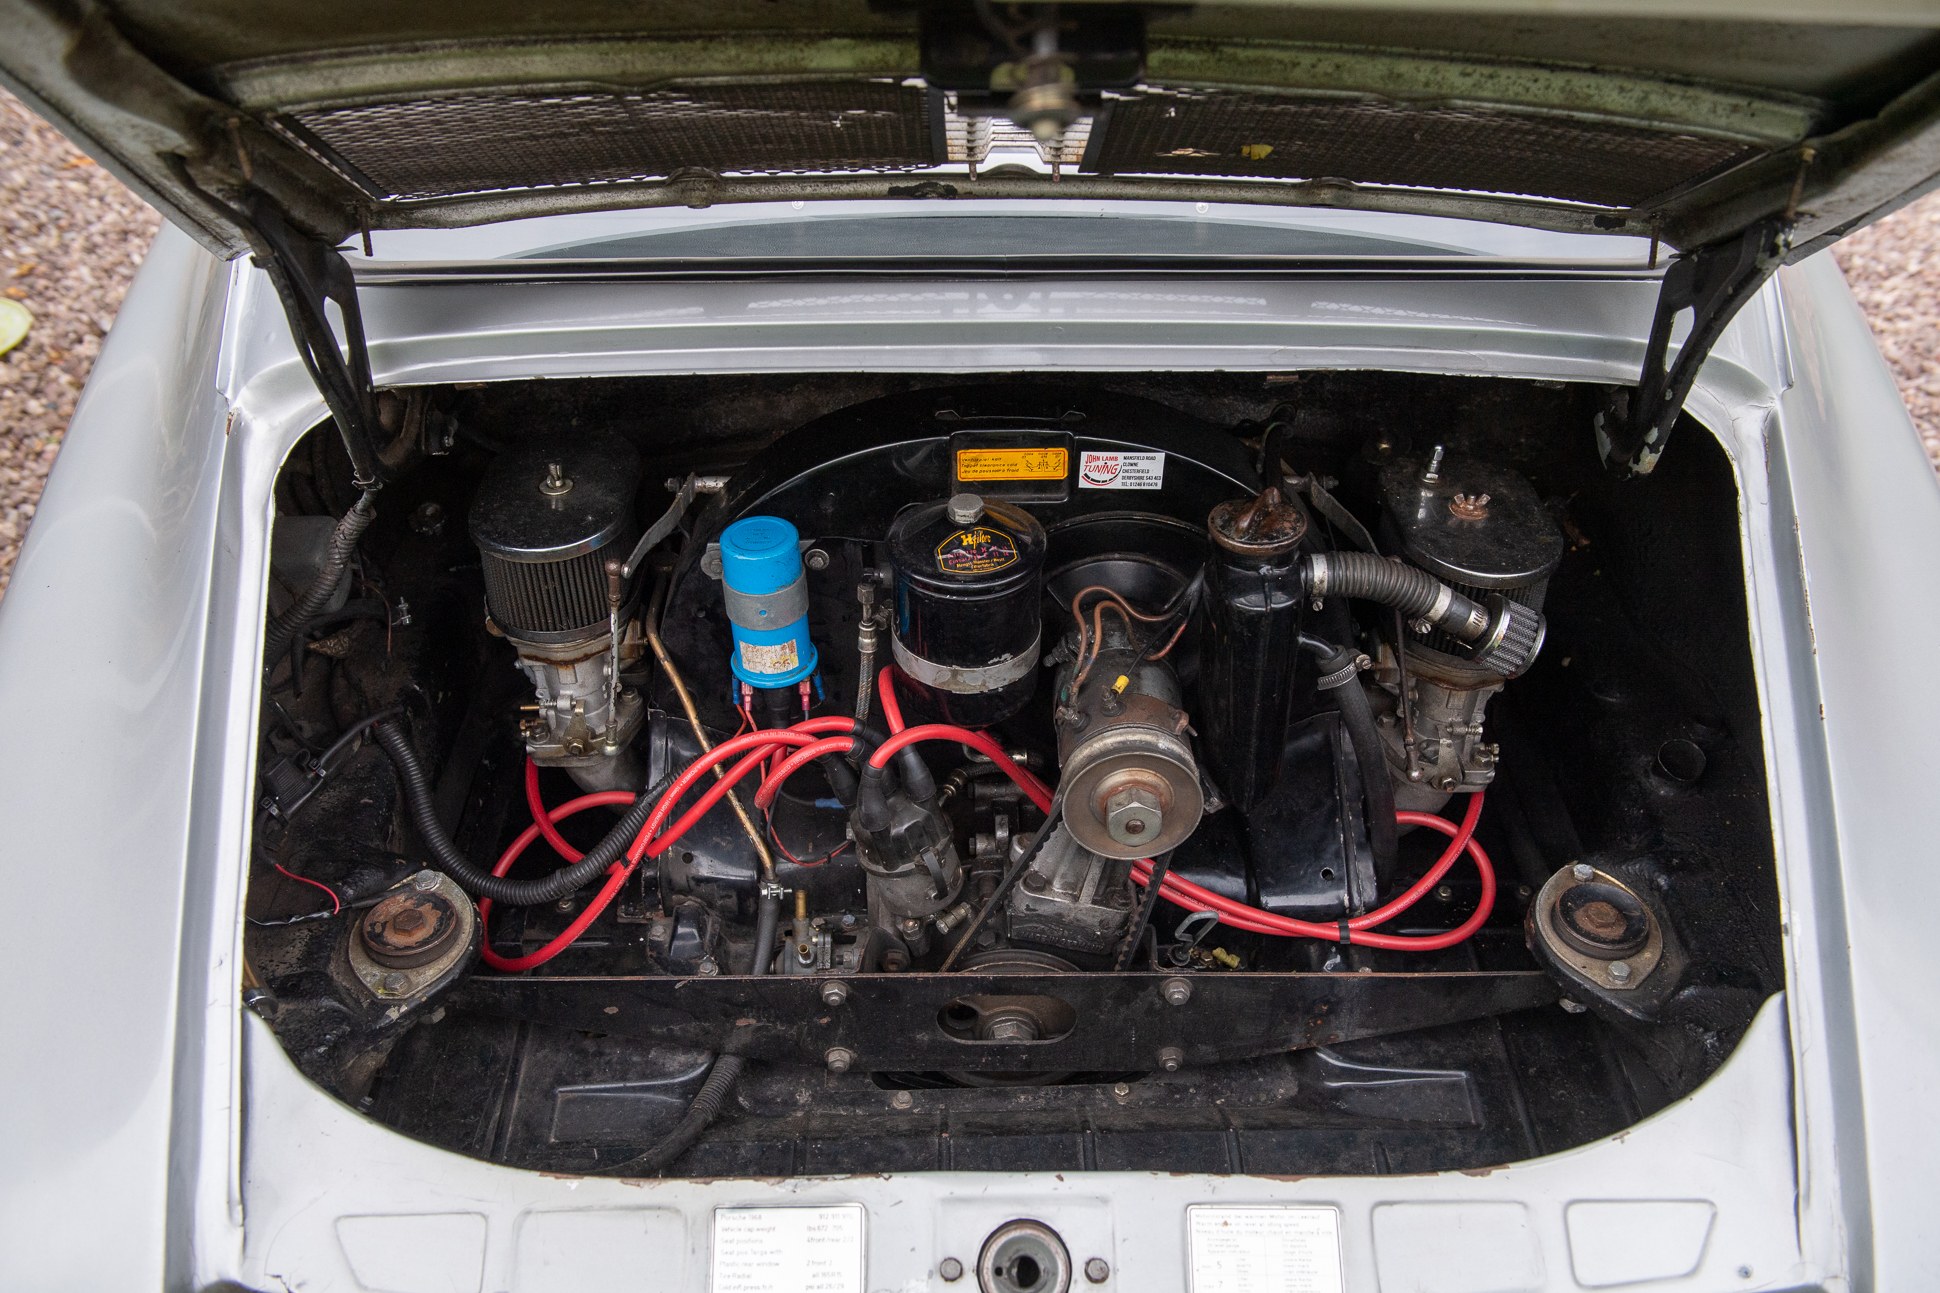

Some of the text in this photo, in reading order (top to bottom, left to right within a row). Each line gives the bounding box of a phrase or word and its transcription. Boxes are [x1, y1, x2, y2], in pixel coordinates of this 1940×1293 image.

[1085, 454, 1100, 464] JOHN
[1084, 462, 1120, 475] TUNING
[660, 799, 670, 812] HIGH
[650, 811, 663, 830] ENERGY
